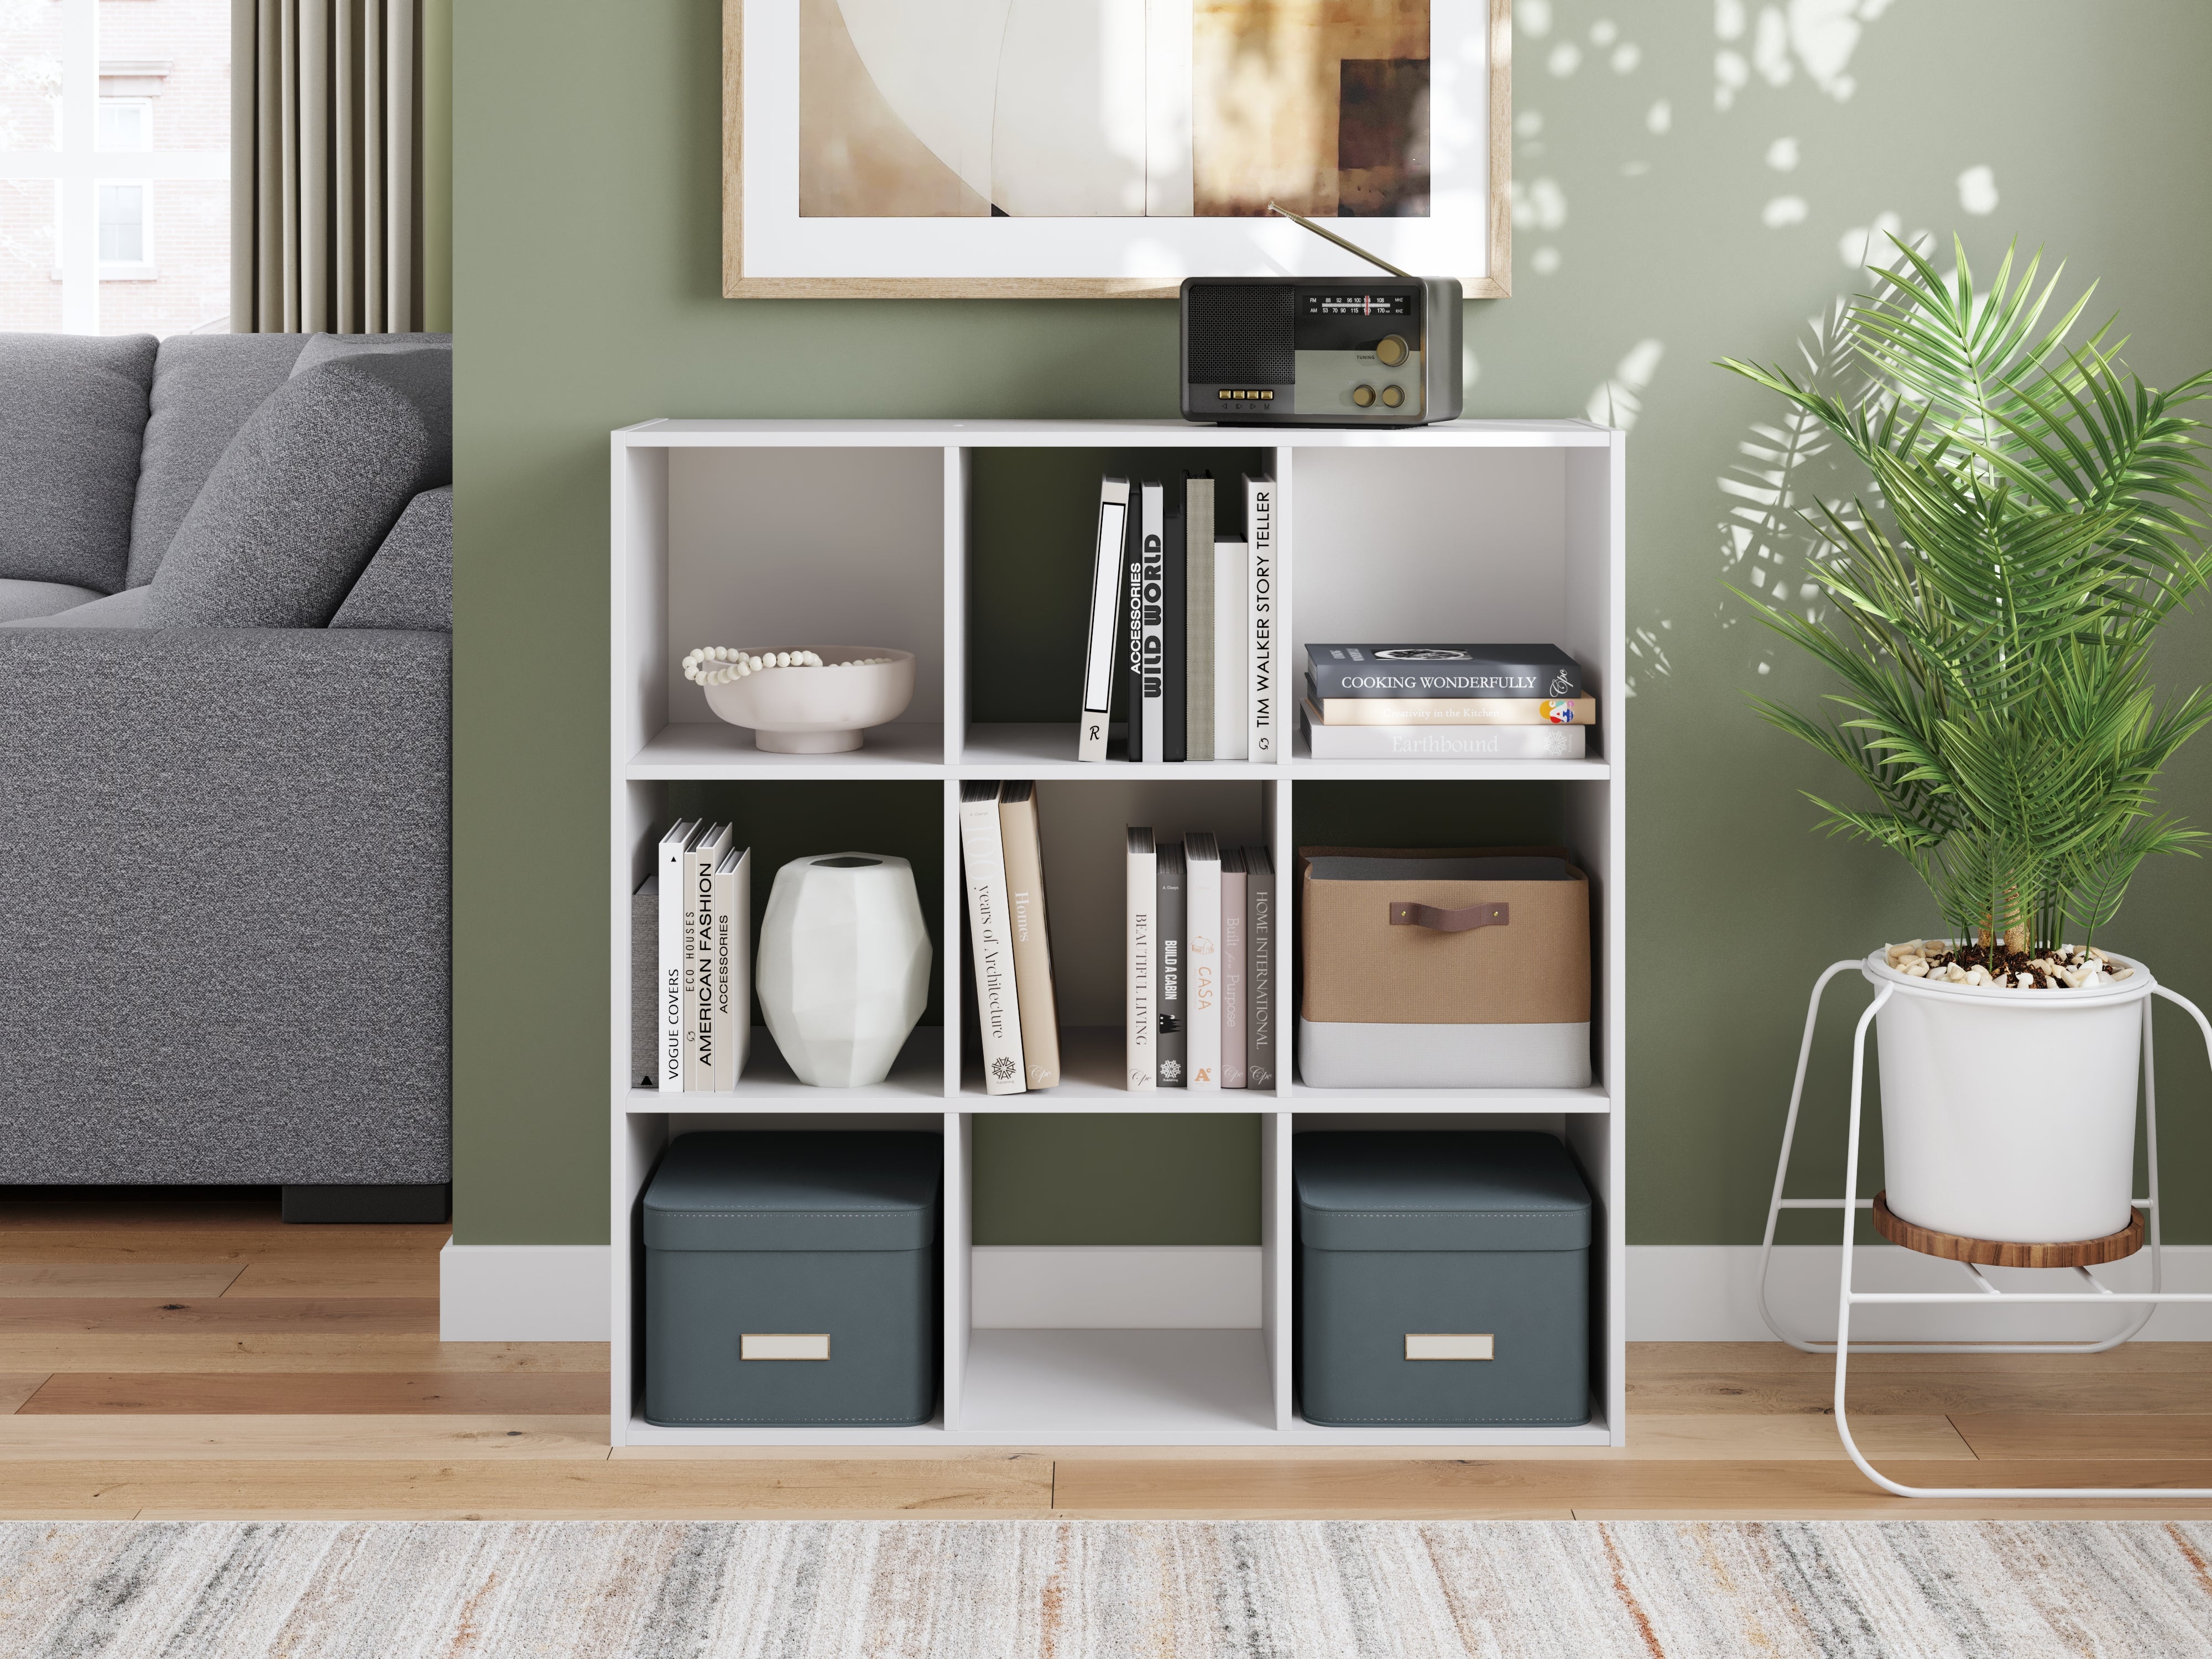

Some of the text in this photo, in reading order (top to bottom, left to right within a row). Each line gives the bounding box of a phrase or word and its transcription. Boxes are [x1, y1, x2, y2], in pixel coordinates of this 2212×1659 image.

[1130, 562, 1141, 675] ACCESSORIES
[1144, 534, 1161, 698] WILD WORLD
[1257, 492, 1269, 728] TIM WALKER STORY TELLER
[1342, 676, 1537, 688] COOKING WONDERFULLY
[1383, 708, 1500, 719] Creativity in the Kitchen
[1392, 735, 1499, 753] Earthbound
[974, 885, 992, 924] years
[1015, 890, 1029, 942] Homes
[686, 911, 695, 992] ECO HOUSES
[983, 930, 999, 944] of
[1165, 940, 1177, 965] BUILD
[1227, 917, 1239, 947] Built
[699, 863, 712, 1067] AMERICAN FASHION
[719, 915, 728, 1014] ACCESSORIES
[1136, 914, 1147, 1045] BEAUTIFUL LIVING
[1165, 974, 1177, 1000] CABIN
[1198, 967, 1213, 1010] CASA
[1256, 892, 1268, 1050] HOME INTERNATIONAL
[984, 948, 1003, 1039] Architecture
[1224, 974, 1239, 1027] Purpose
[669, 969, 679, 1079] VOGUE COVERS
